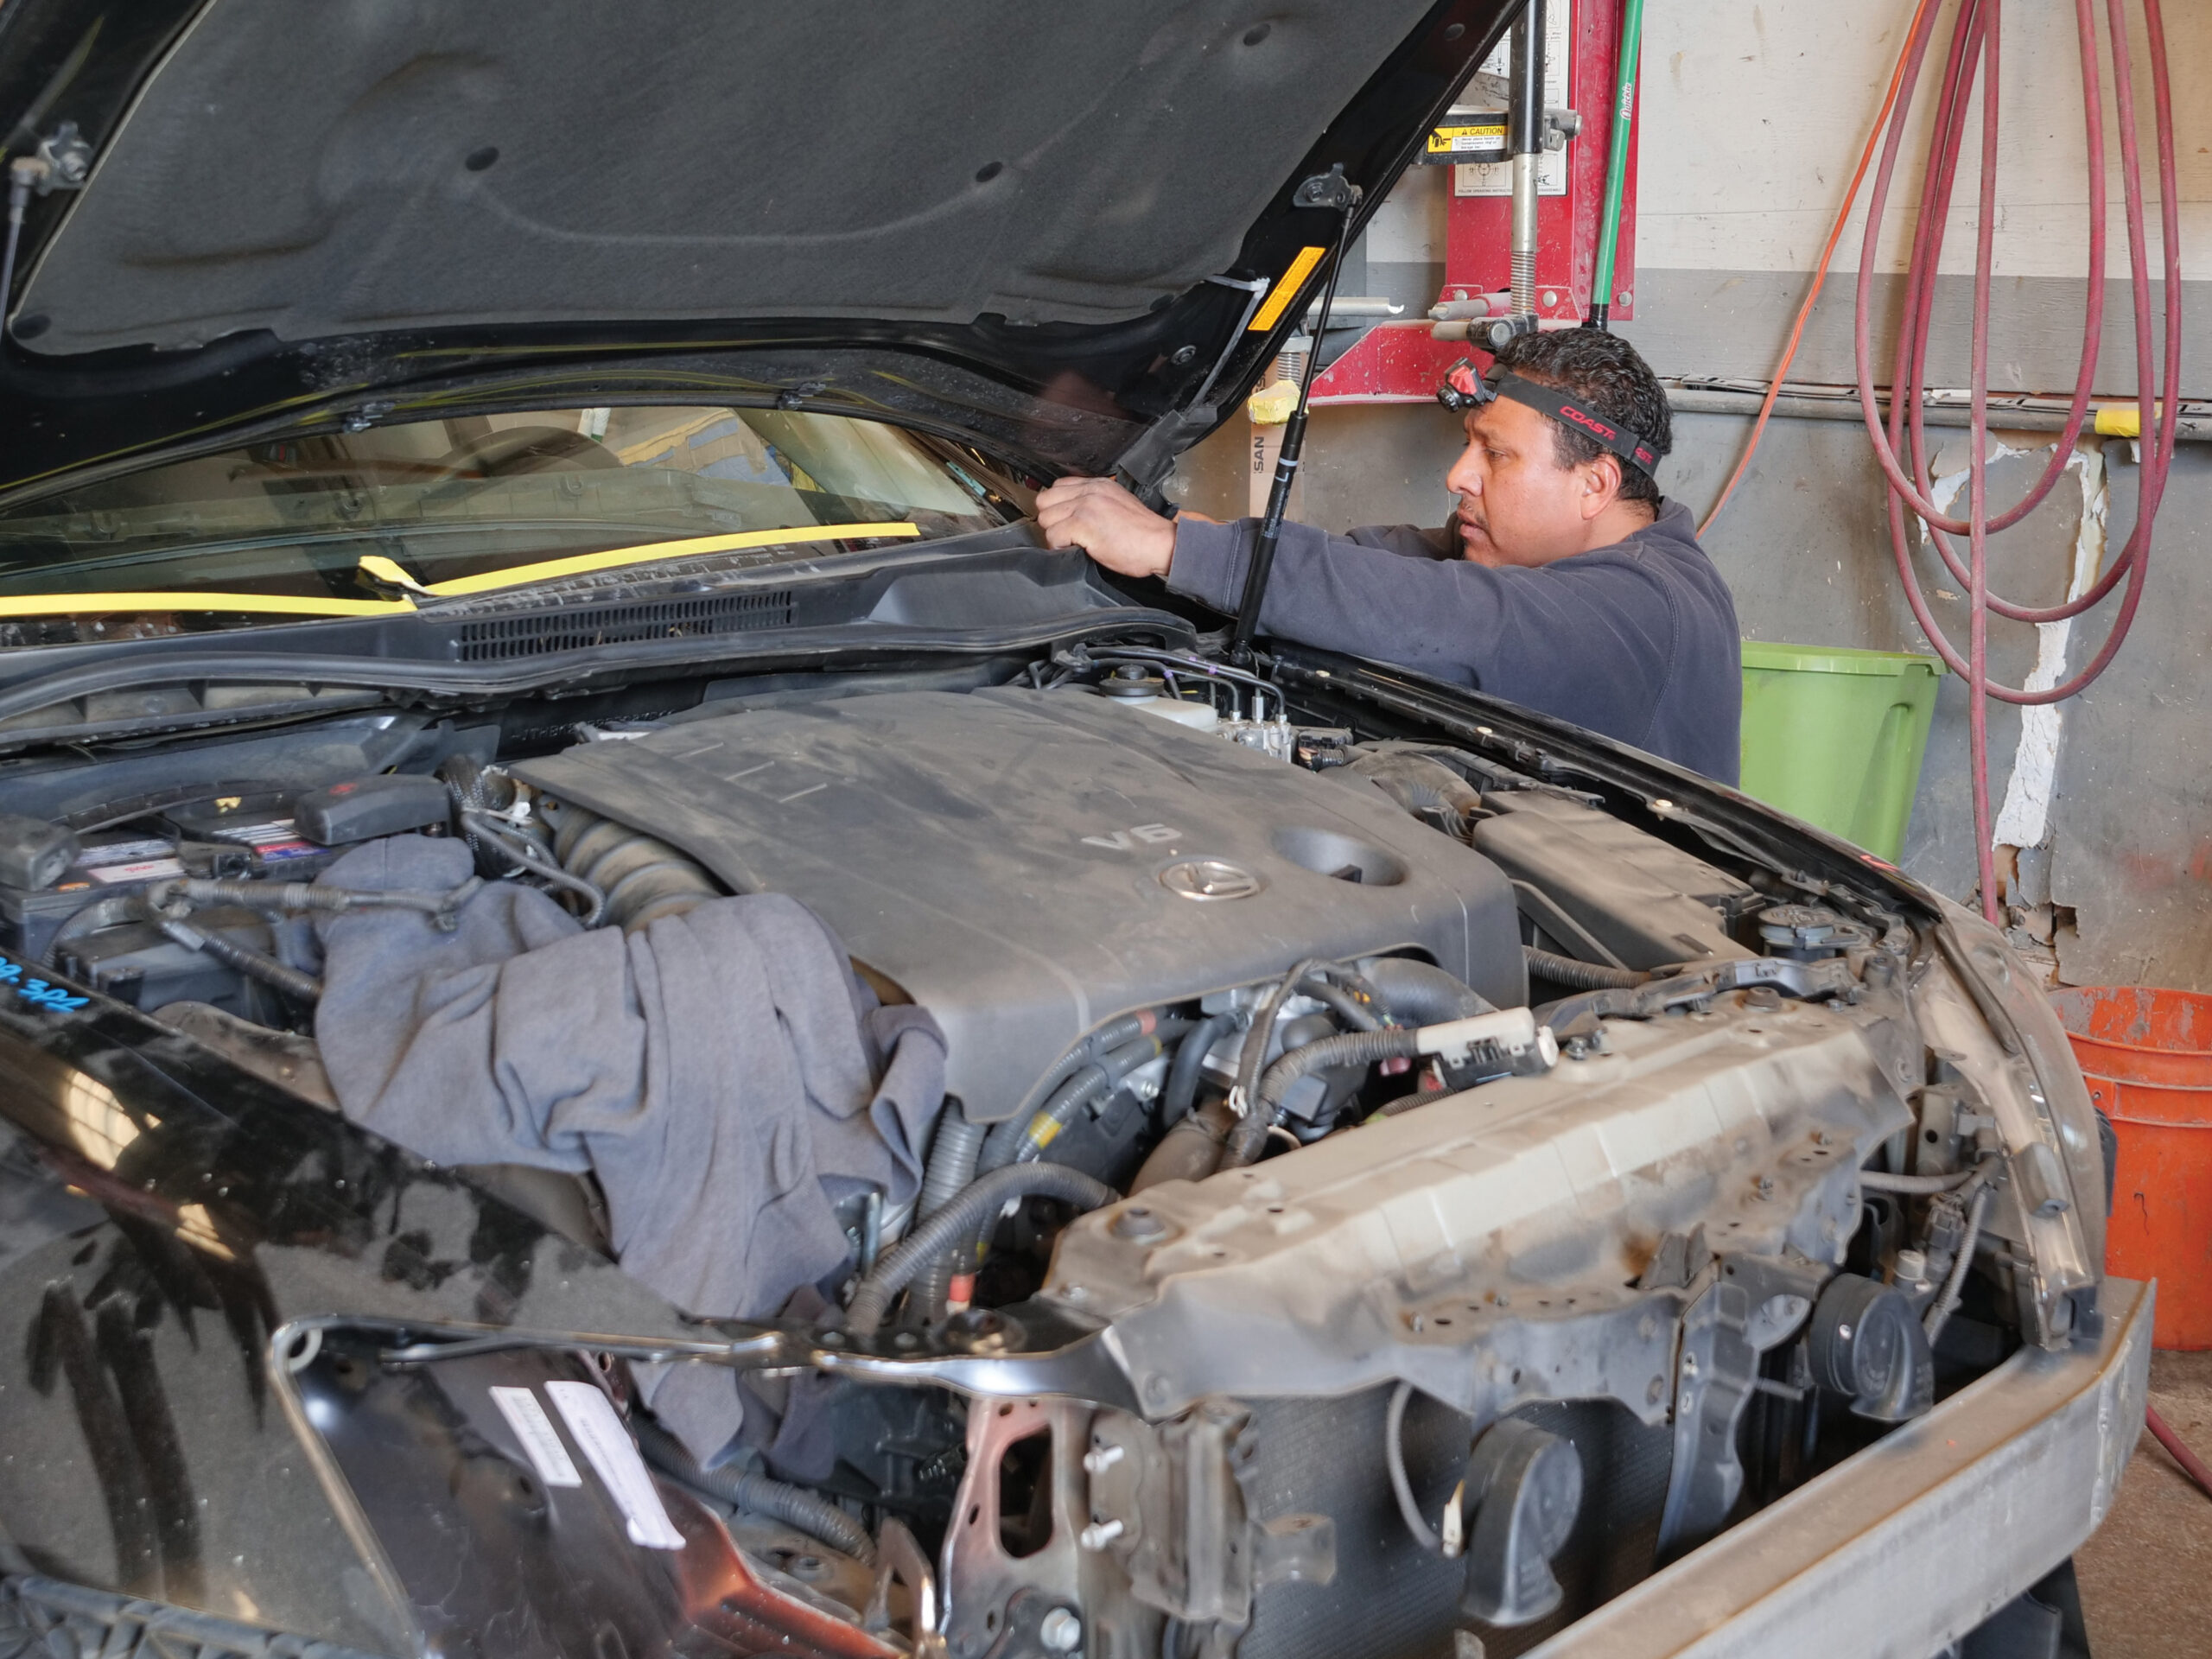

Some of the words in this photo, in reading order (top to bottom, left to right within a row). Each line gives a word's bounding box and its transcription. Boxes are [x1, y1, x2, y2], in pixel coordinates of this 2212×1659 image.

[1620, 82, 1632, 119] Quickie
[1560, 405, 1617, 439] COAST
[1080, 823, 1182, 849] V6
